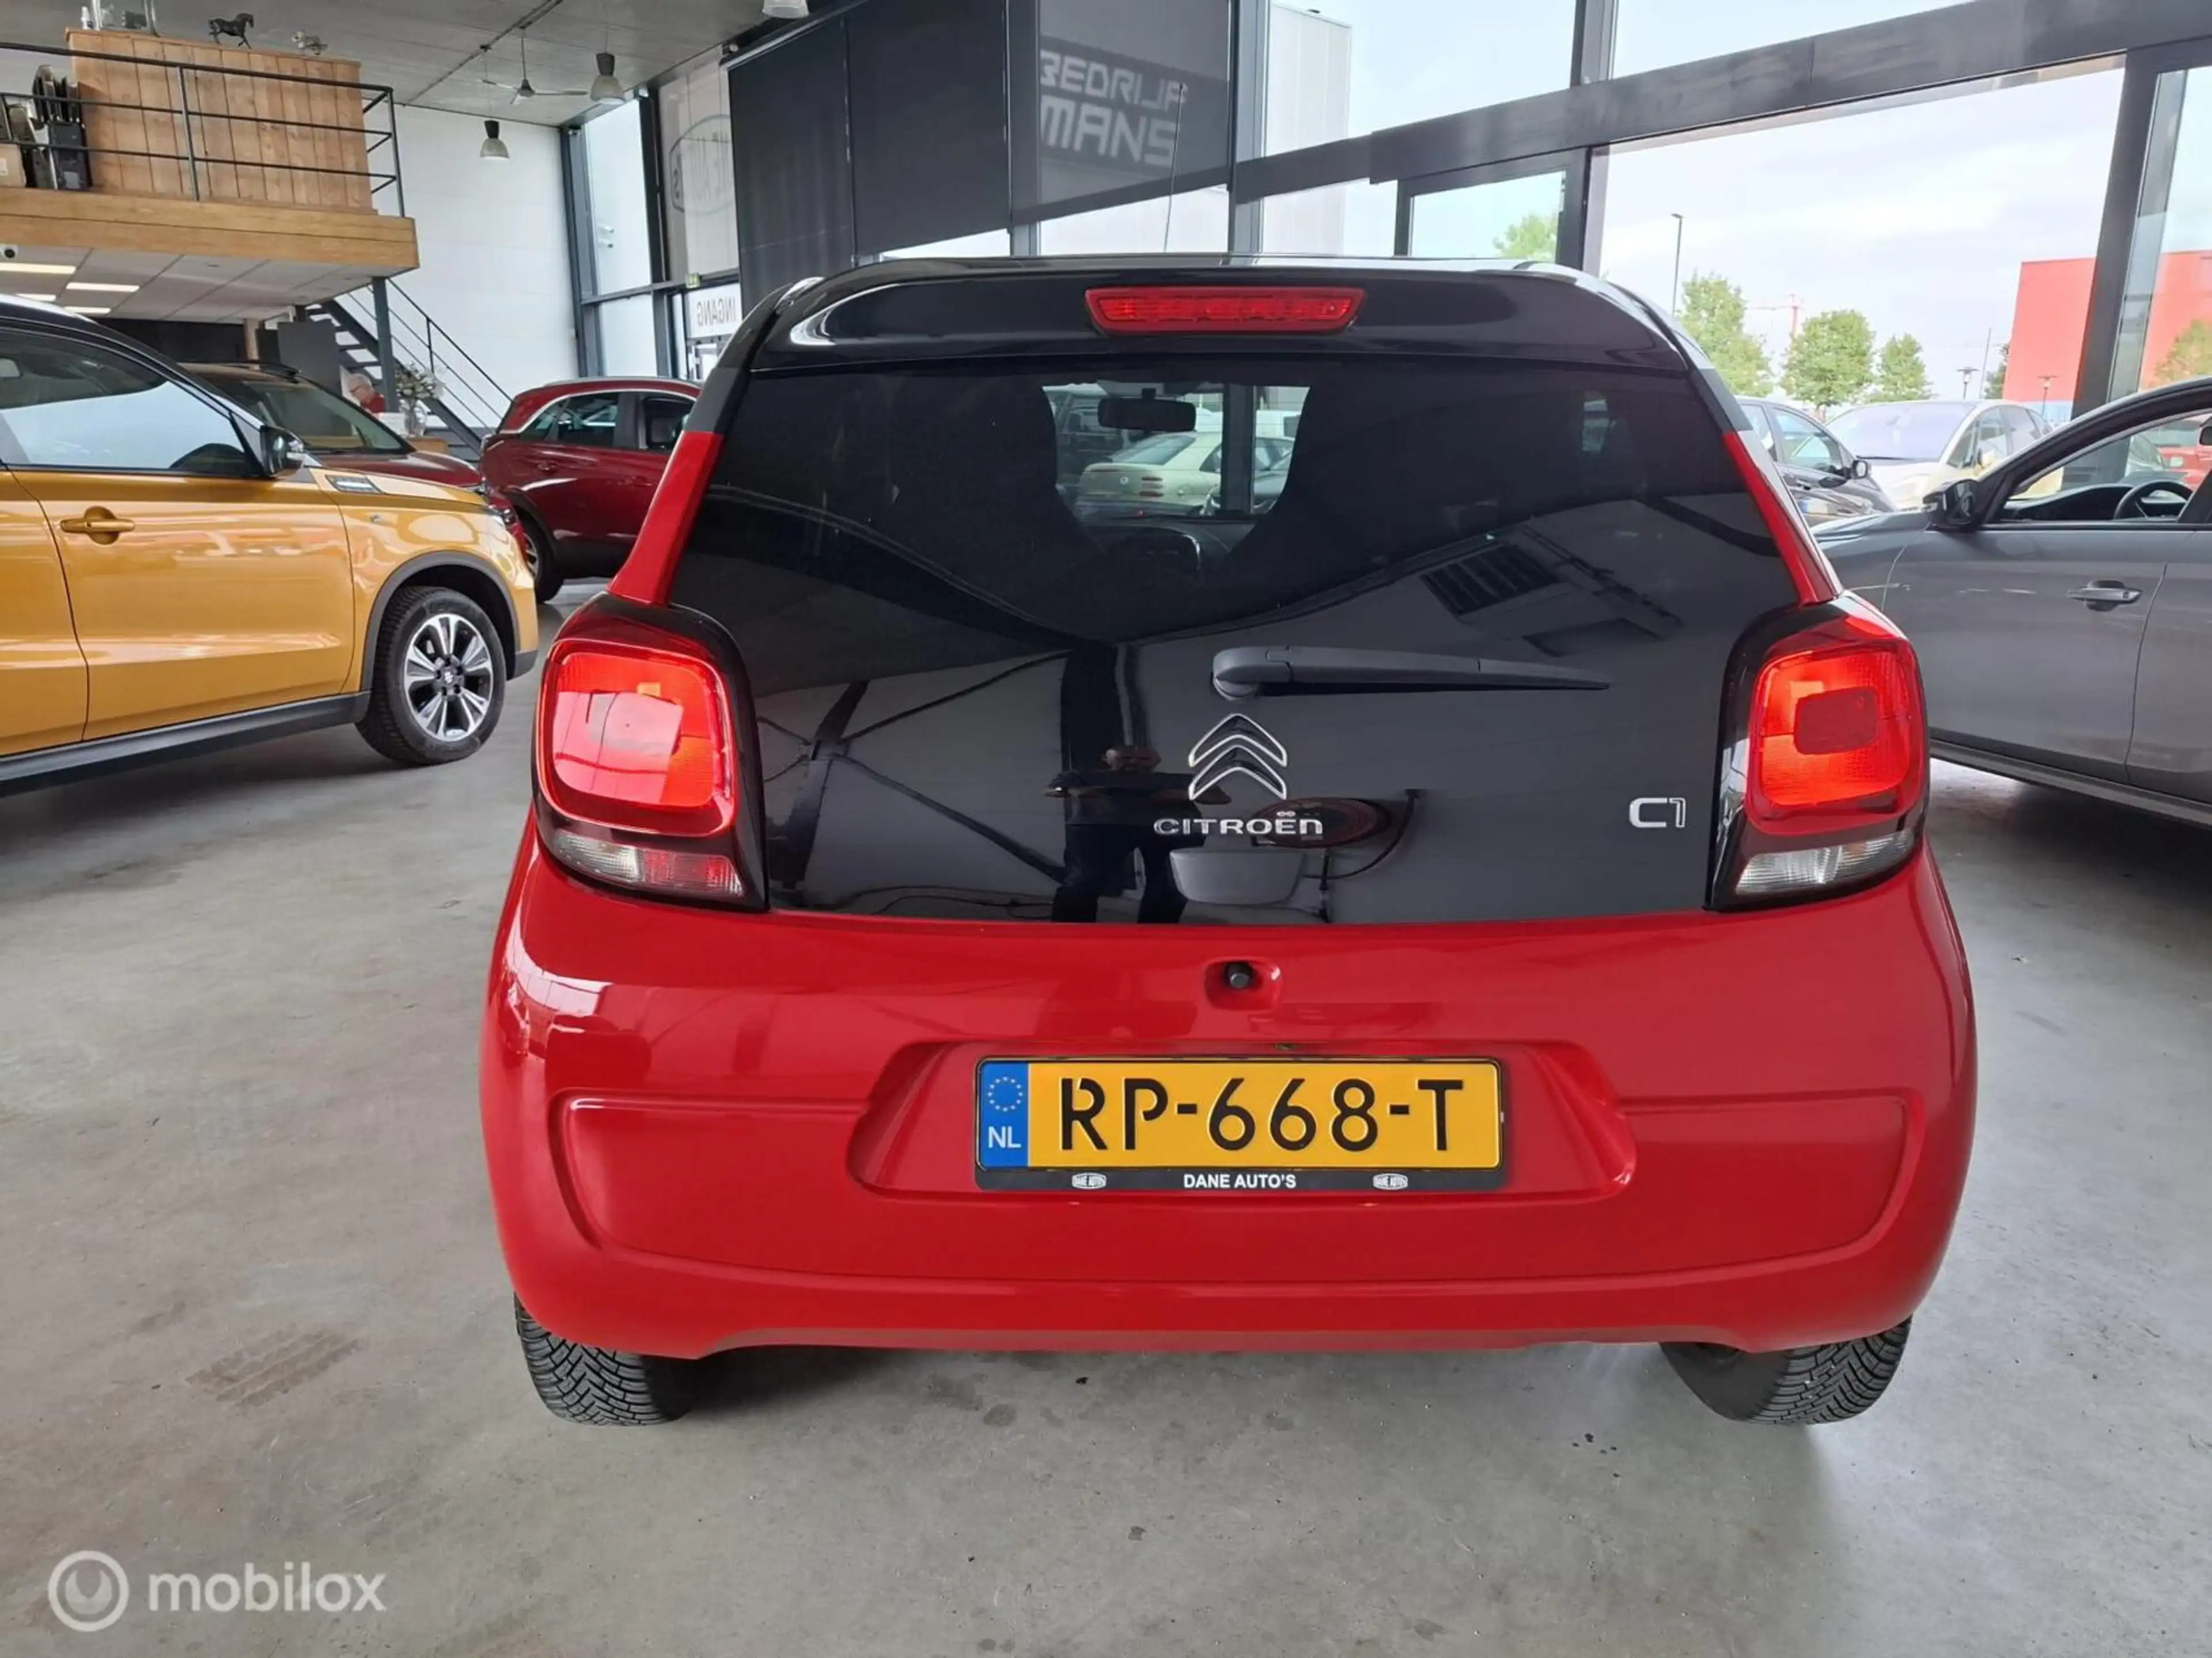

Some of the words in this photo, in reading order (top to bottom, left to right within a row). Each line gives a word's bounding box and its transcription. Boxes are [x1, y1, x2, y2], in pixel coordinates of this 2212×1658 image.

[1040, 94, 1179, 166] MANS
[1629, 797, 1686, 828] C1
[1060, 1077, 1464, 1152] RP-668-T
[988, 1126, 1021, 1149] NL
[1183, 1173, 1230, 1189] DANE
[1234, 1173, 1297, 1189] AUTO'S
